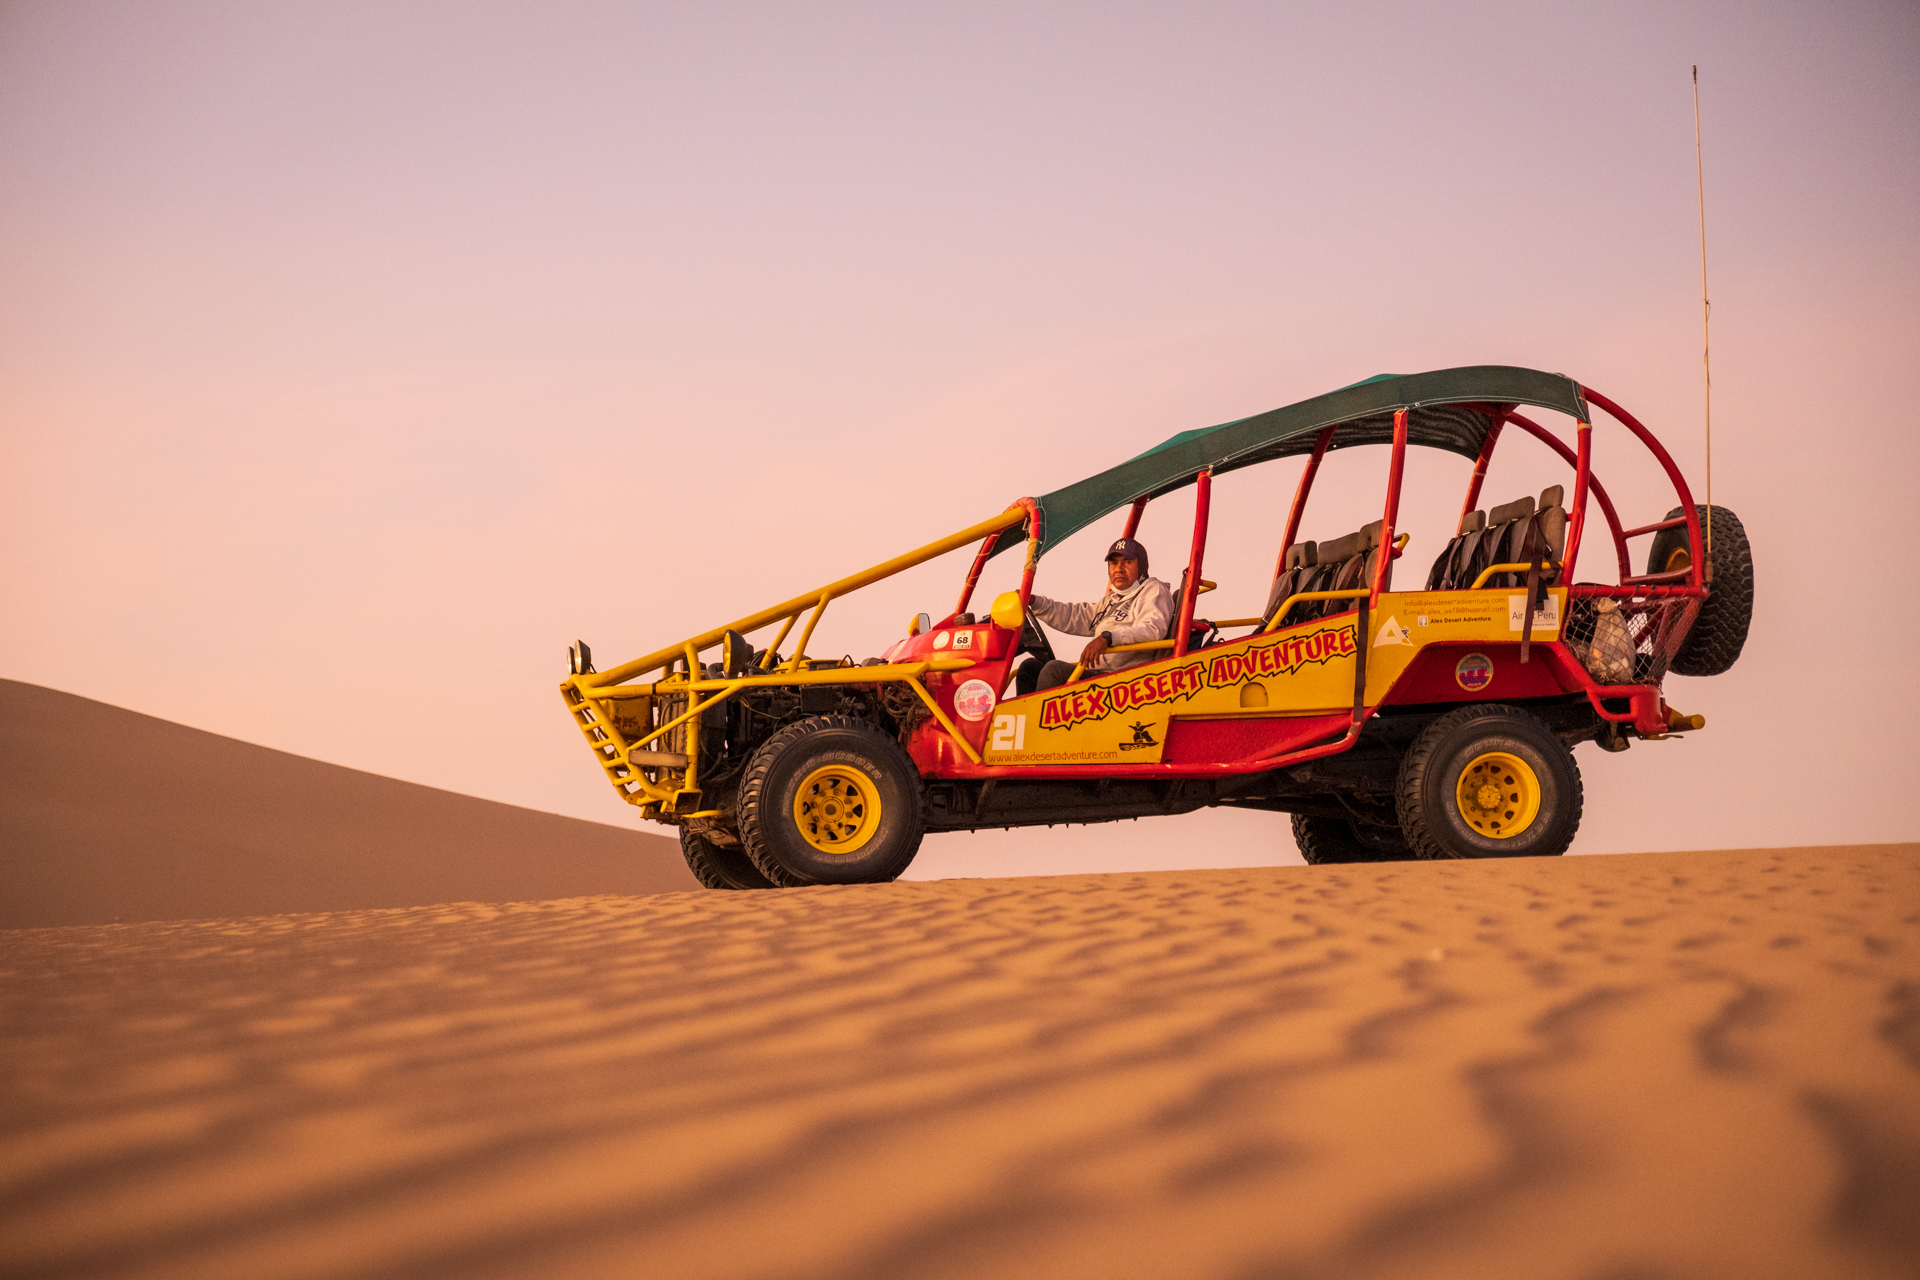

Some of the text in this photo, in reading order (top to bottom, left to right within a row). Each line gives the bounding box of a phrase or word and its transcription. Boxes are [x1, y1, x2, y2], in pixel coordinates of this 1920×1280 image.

[1115, 539, 1126, 550] NY
[1512, 611, 1523, 620] Air
[1537, 611, 1557, 620] Peru
[956, 636, 969, 645] 68
[1044, 629, 1354, 725] ALEX DESERT ADVENTURE
[991, 714, 1026, 751] 21
[988, 750, 1118, 763] www.alexdesertadventure.com
[822, 752, 883, 780] MUDDER
